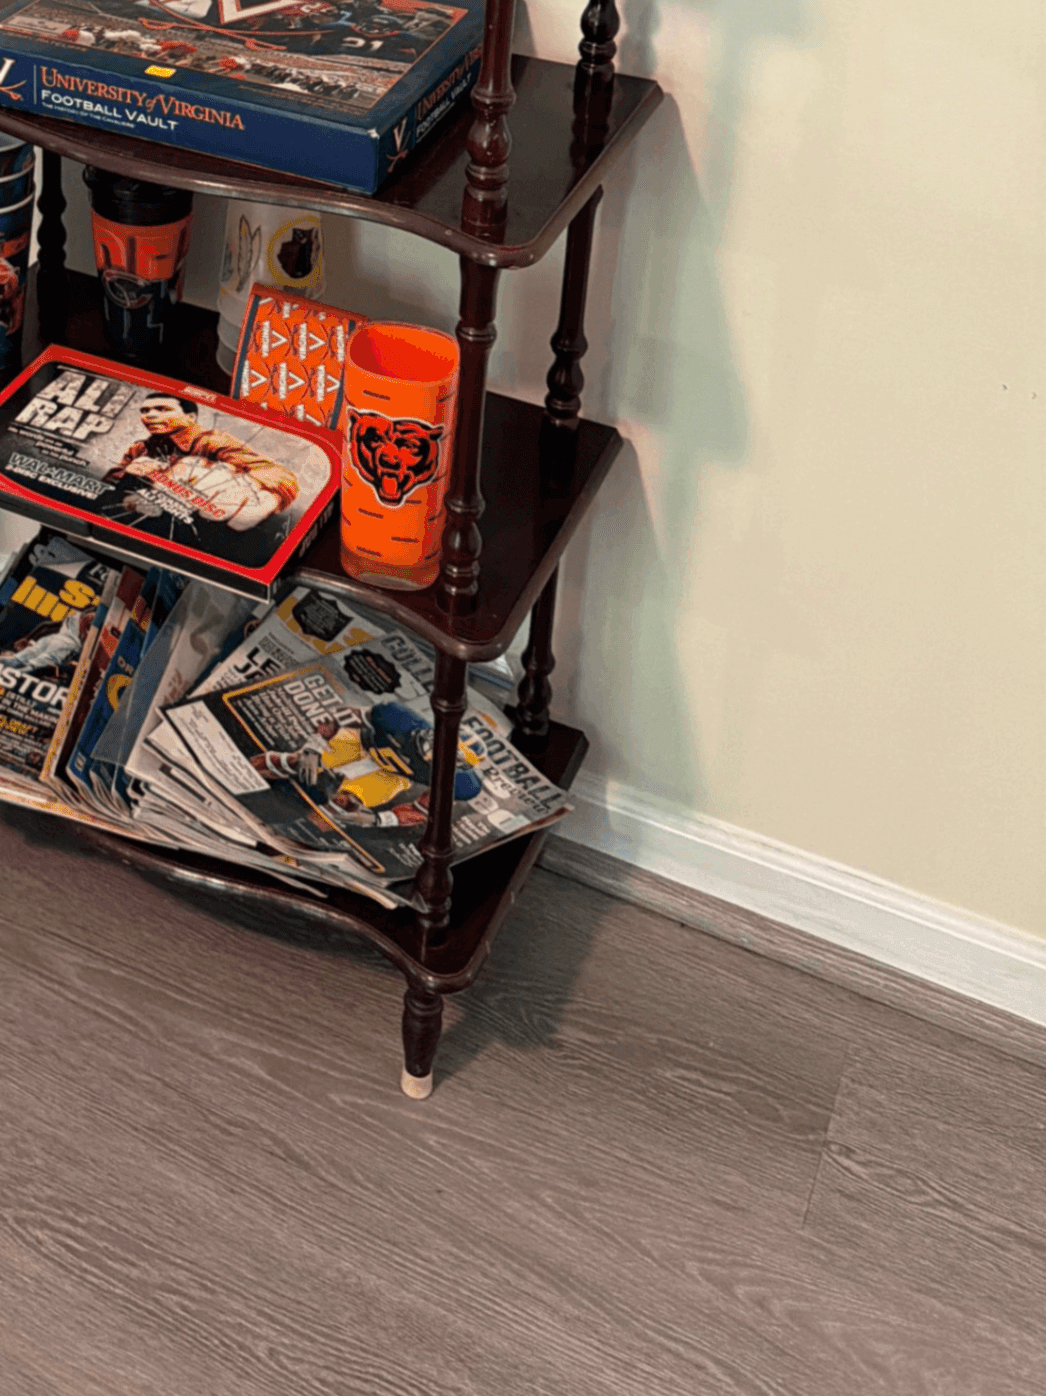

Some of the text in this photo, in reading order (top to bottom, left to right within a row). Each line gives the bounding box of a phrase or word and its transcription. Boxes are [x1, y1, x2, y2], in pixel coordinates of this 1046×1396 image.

[40, 65, 148, 107] UNIVERSITY
[156, 95, 245, 131] VIRGINIA
[41, 90, 179, 131] FOOTBALL VAULT
[14, 397, 114, 441] RAP
[35, 370, 135, 419] ALI
[149, 469, 226, 518] BONUS DISC
[30, 708, 60, 723] MAKIN
[283, 680, 334, 727] DONE
[304, 674, 344, 706] GET
[334, 708, 362, 725] IT
[462, 715, 562, 812] FOOTBALL
[482, 766, 551, 815] Preview
